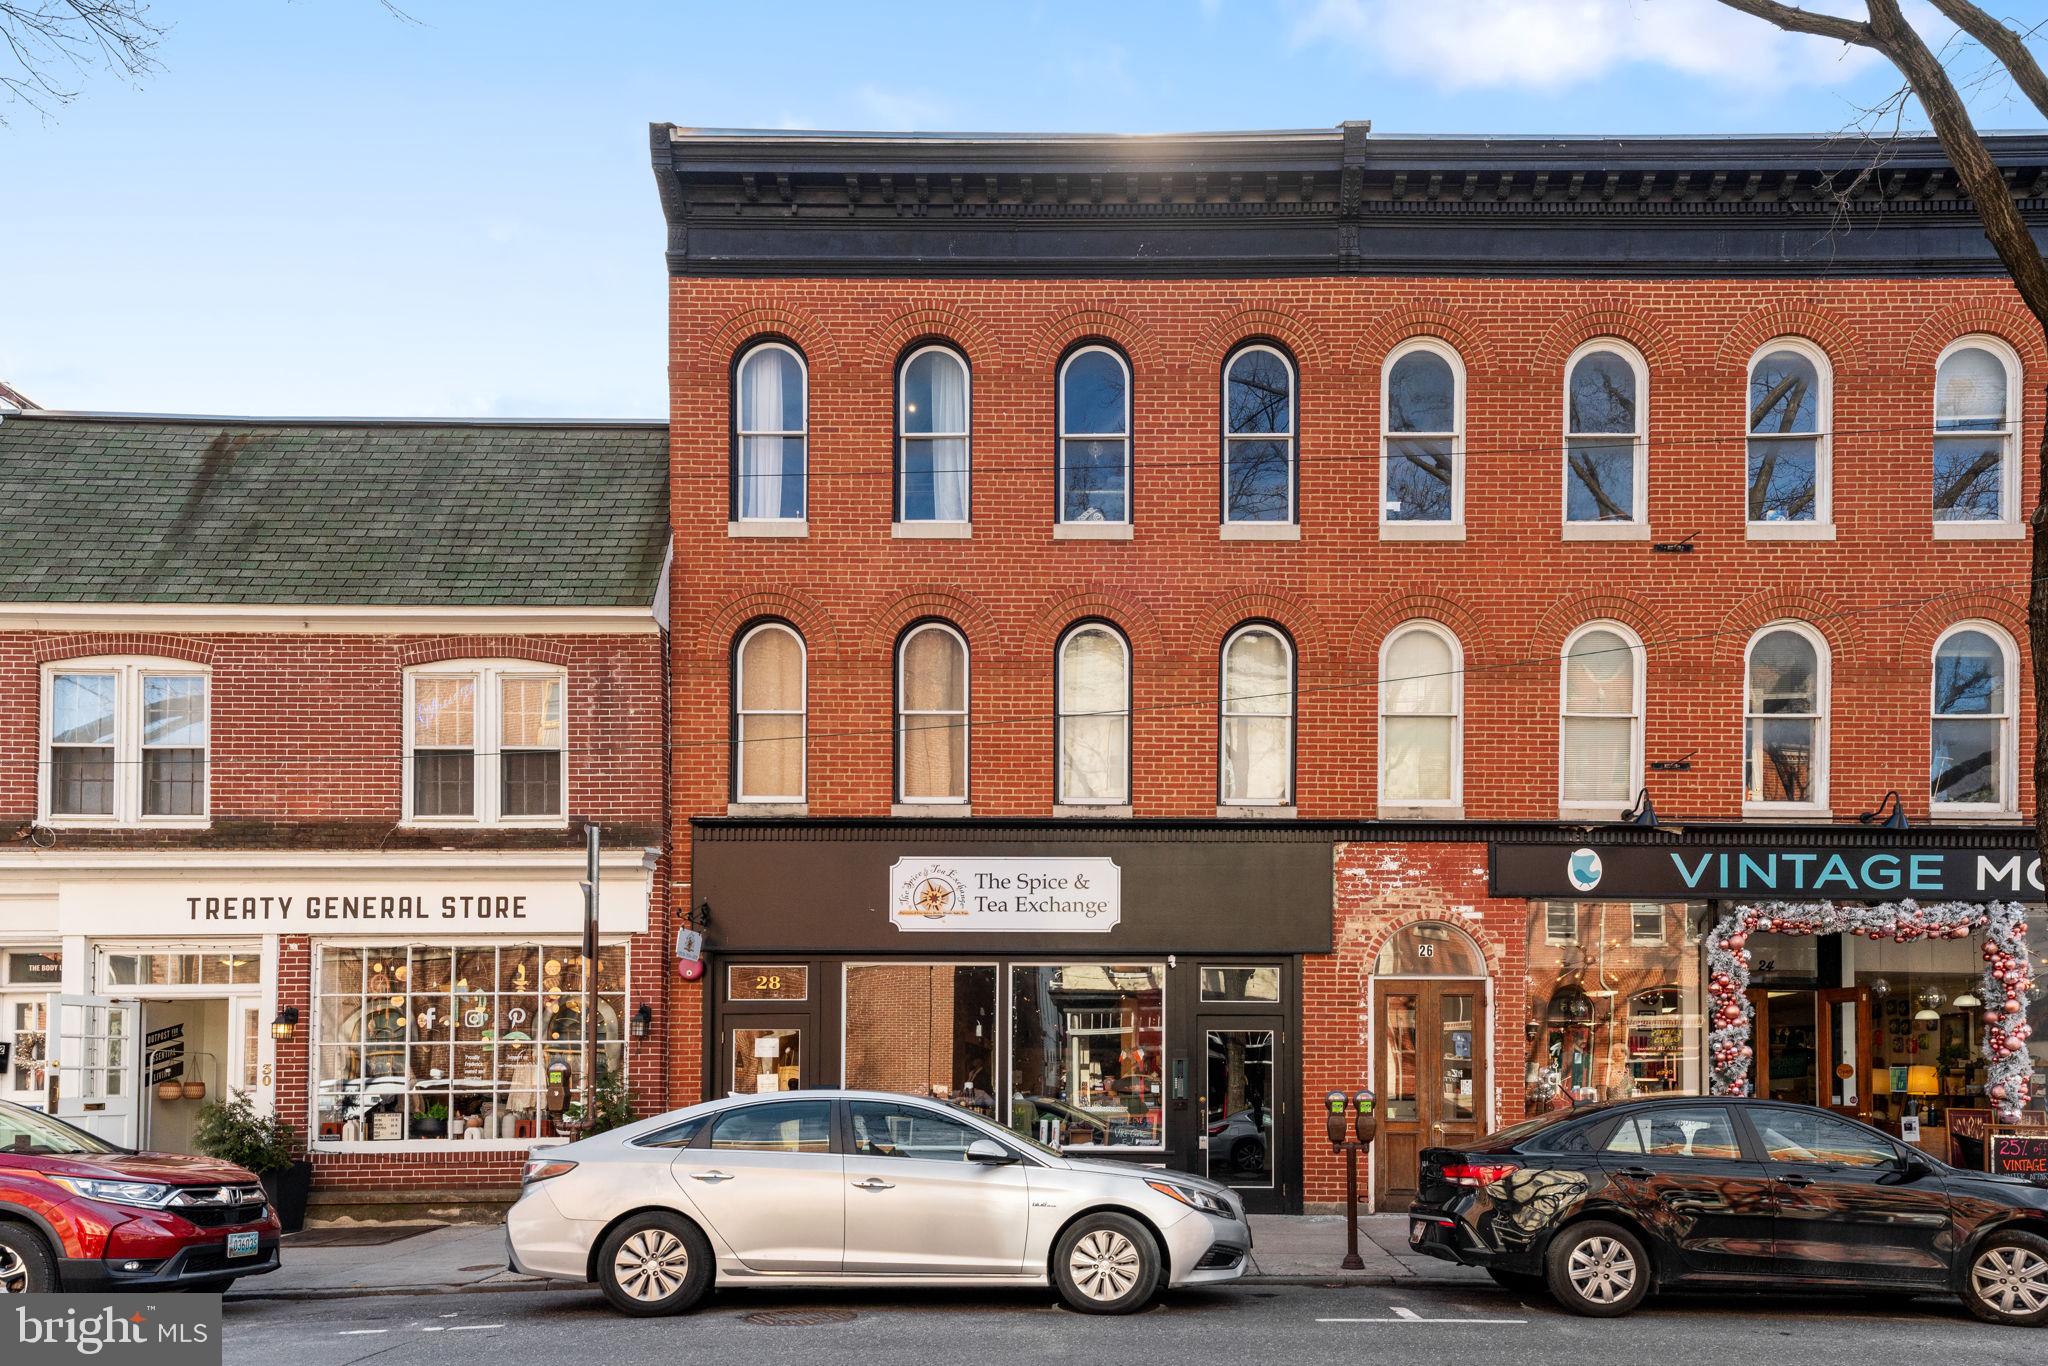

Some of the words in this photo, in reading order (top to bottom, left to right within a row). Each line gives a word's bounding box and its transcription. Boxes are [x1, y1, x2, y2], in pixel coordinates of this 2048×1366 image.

[1670, 853, 1944, 890] VINTAGE
[975, 873, 1011, 889] The
[1017, 873, 1068, 894] Spice
[1074, 873, 1090, 889] &
[186, 897, 293, 919] TREATY
[306, 896, 429, 918] GENERAL
[441, 896, 526, 918] STORE
[975, 896, 1008, 912] Tea
[1015, 896, 1108, 918] Exchange
[1419, 945, 1433, 957] 26
[28, 964, 41, 972] THE
[41, 964, 58, 972] BODY
[1758, 960, 1774, 972] 24
[755, 975, 781, 990] 28
[262, 1063, 272, 1087] 30
[2000, 1139, 2028, 1156] 25%
[2003, 1158, 2047, 1172] VINTAGE
